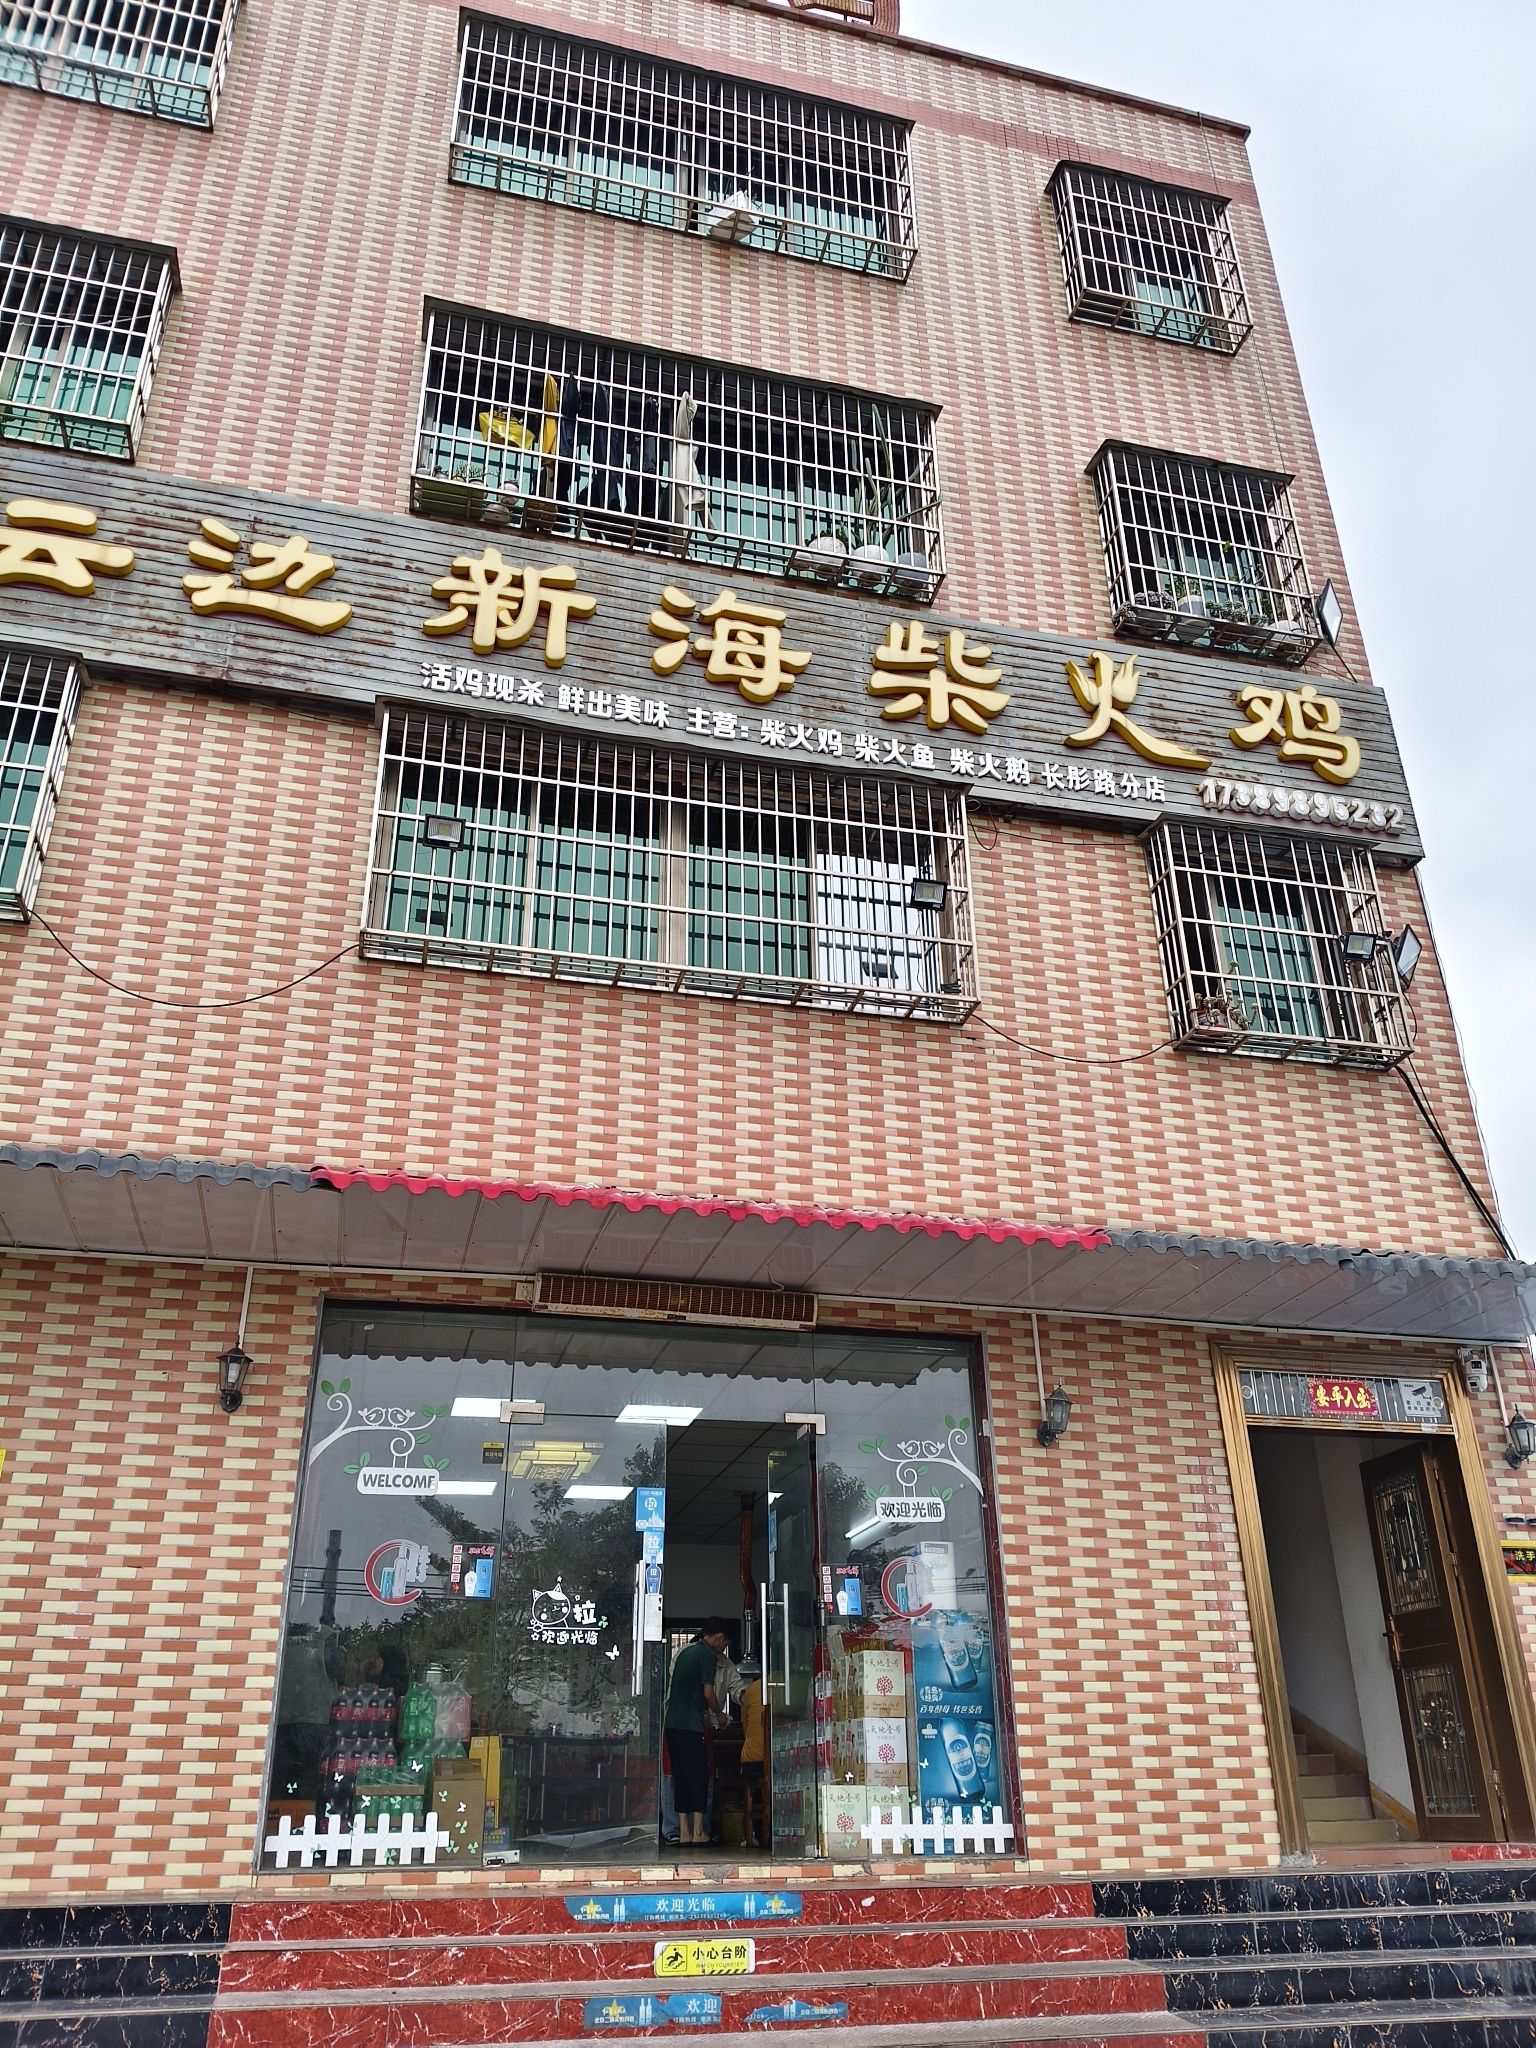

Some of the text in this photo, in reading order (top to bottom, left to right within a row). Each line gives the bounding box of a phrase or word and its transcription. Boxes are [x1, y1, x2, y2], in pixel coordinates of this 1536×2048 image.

[420, 661, 545, 707] 活鸡现杀
[557, 683, 670, 729] 鲜出美味
[760, 718, 842, 758] 柴火鸡
[853, 733, 935, 771] 柴火鱼
[950, 748, 1030, 785] 柴火鹅
[880, 1502, 941, 1518] 欢迎光临
[1514, 1550, 1536, 1561] 洗手
[572, 1599, 597, 1625] 拉
[541, 1629, 599, 1646] 欢迎光临
[869, 1658, 899, 1668] 天地壹号
[870, 1725, 901, 1735] 天地壹号
[829, 1792, 861, 1802] 天地壹号
[656, 1897, 716, 1912] 欢迎光临
[692, 1945, 747, 1960] 小心台阶
[686, 1998, 717, 2014] 欢迎
